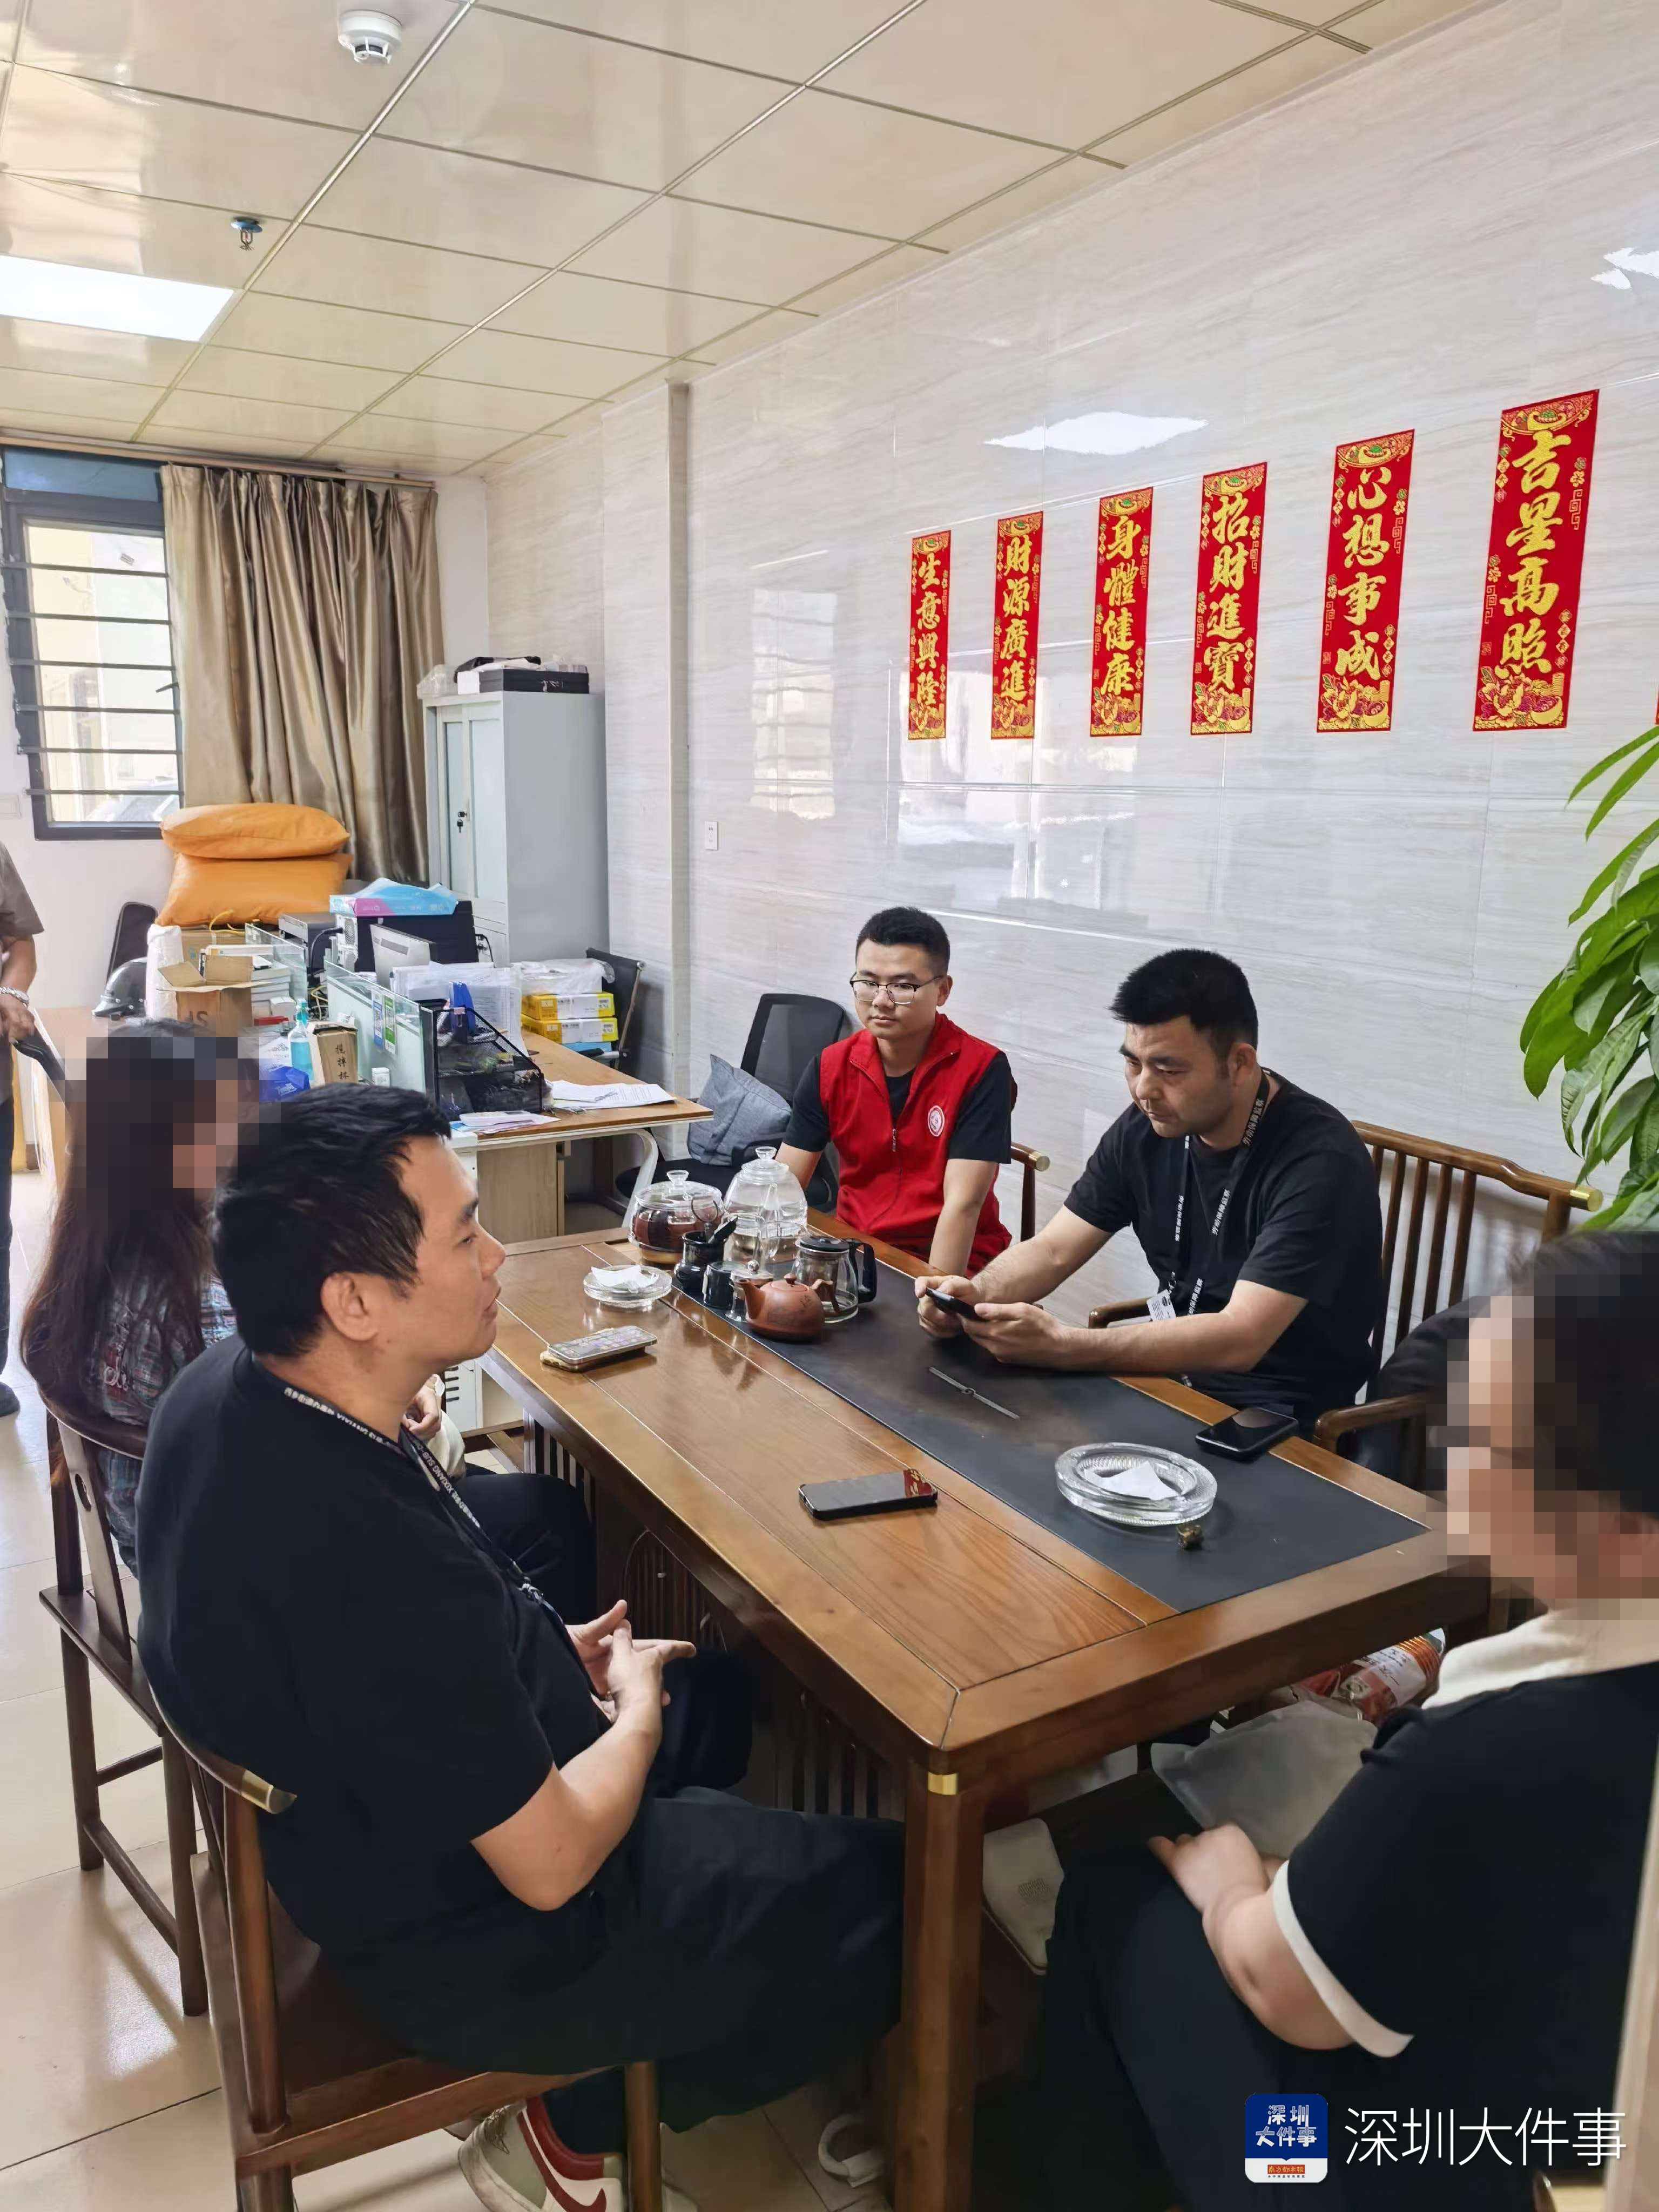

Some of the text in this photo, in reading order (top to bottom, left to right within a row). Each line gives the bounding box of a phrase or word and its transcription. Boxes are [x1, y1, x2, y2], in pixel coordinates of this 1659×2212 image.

[1334, 467, 1392, 680] 心想事成
[1494, 430, 1572, 678] 吉星高照
